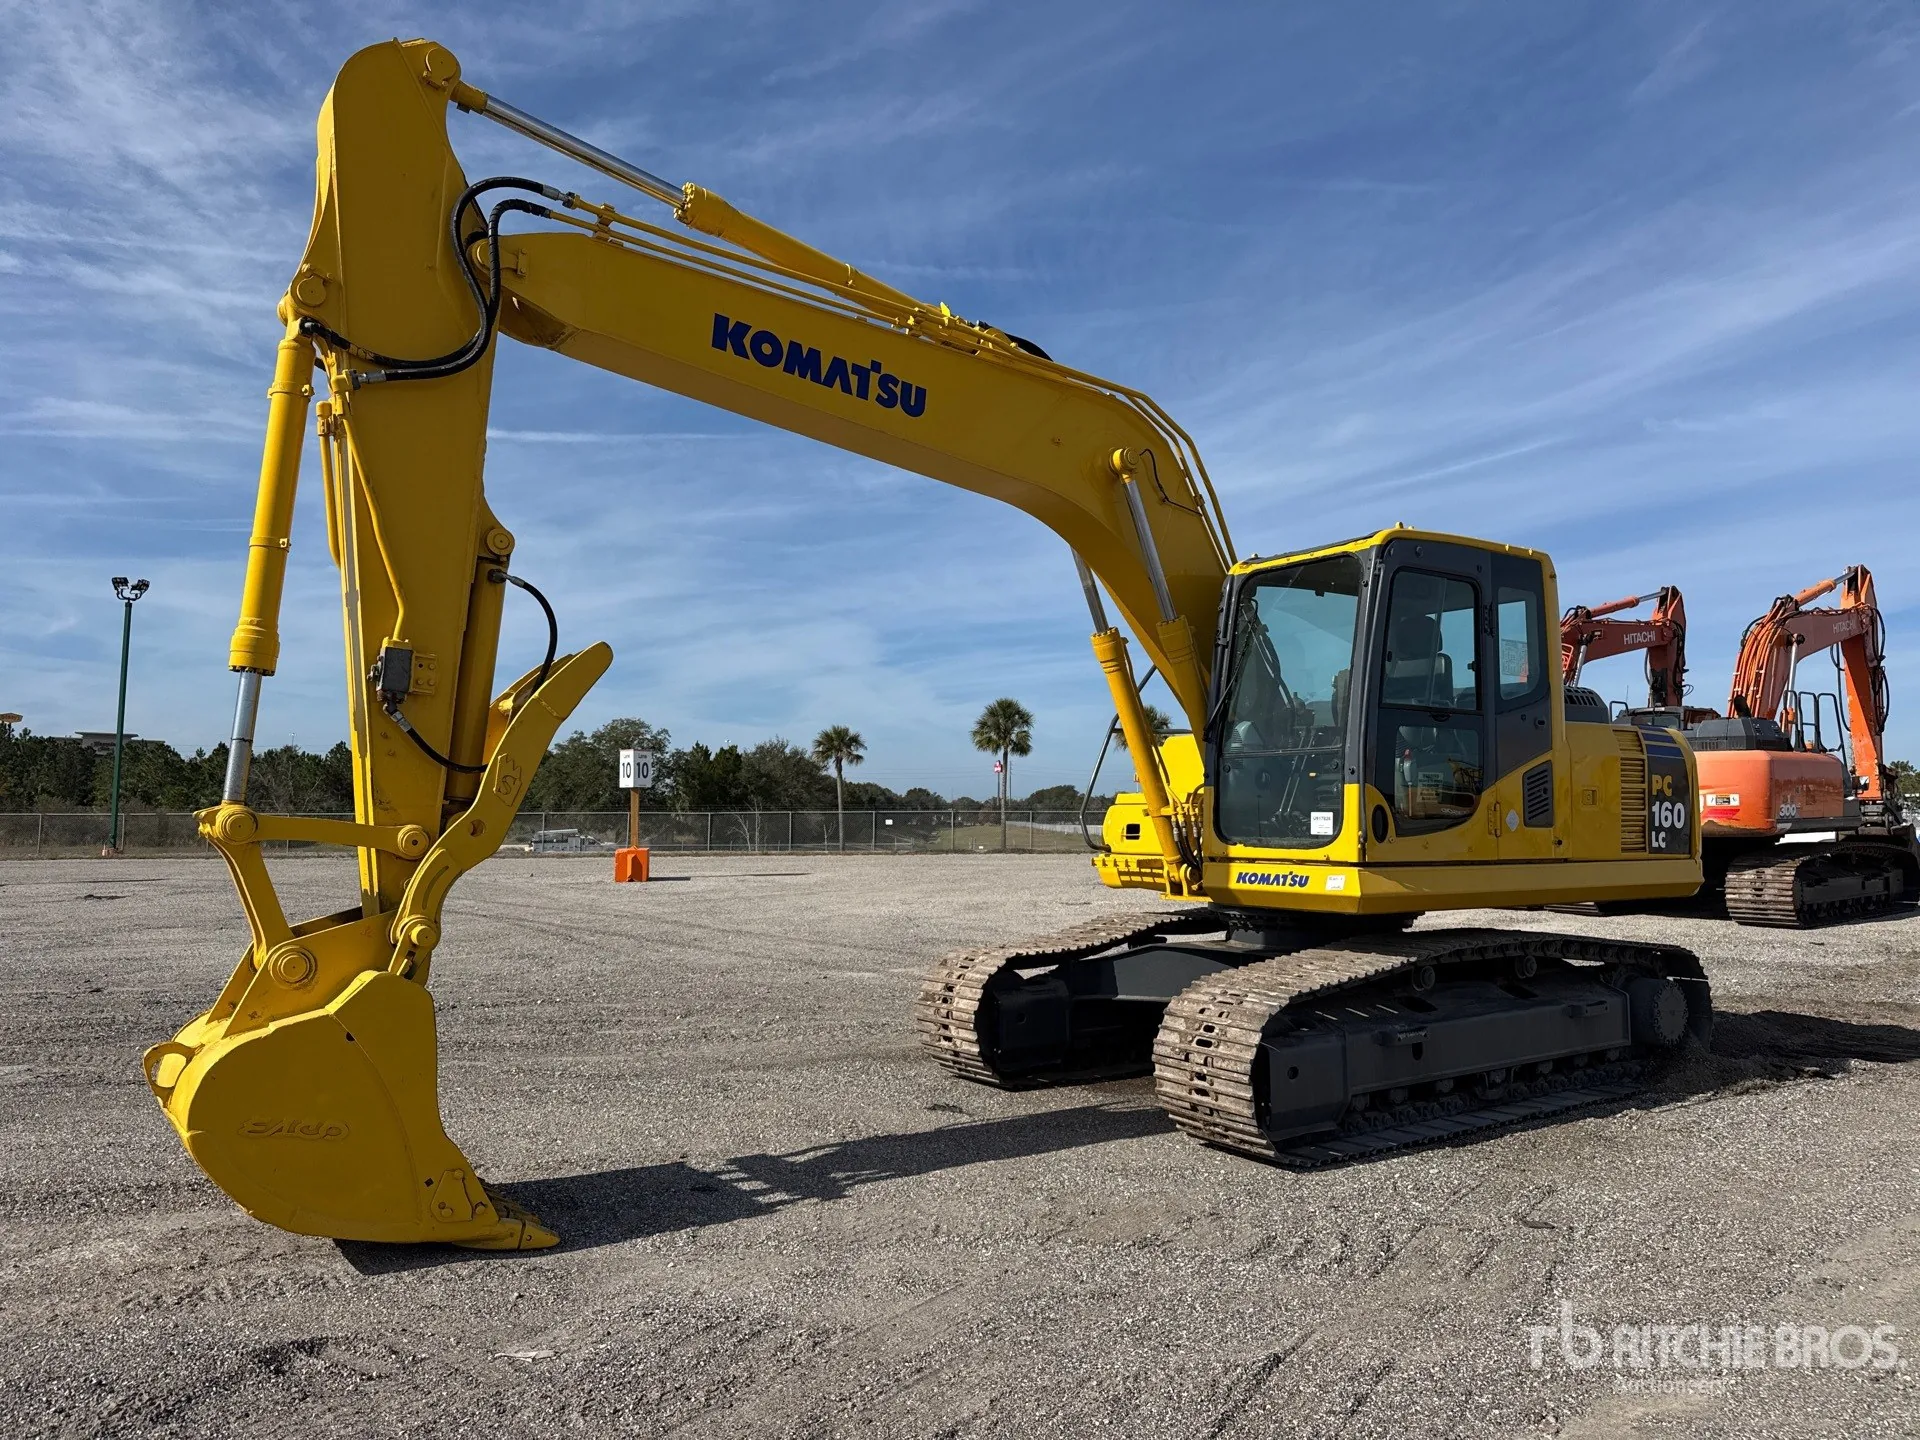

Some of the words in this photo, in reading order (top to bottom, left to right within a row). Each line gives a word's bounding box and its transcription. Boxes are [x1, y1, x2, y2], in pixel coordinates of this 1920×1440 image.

[711, 313, 927, 417] KOMATSU
[1623, 631, 1656, 645] HITACHI
[622, 762, 632, 779] 10
[636, 762, 649, 779] 10
[1651, 774, 1673, 797] PC
[1651, 801, 1685, 829] 160
[1780, 804, 1797, 817] 300
[1651, 831, 1666, 849] LC
[1236, 871, 1310, 888] KOMATSU
